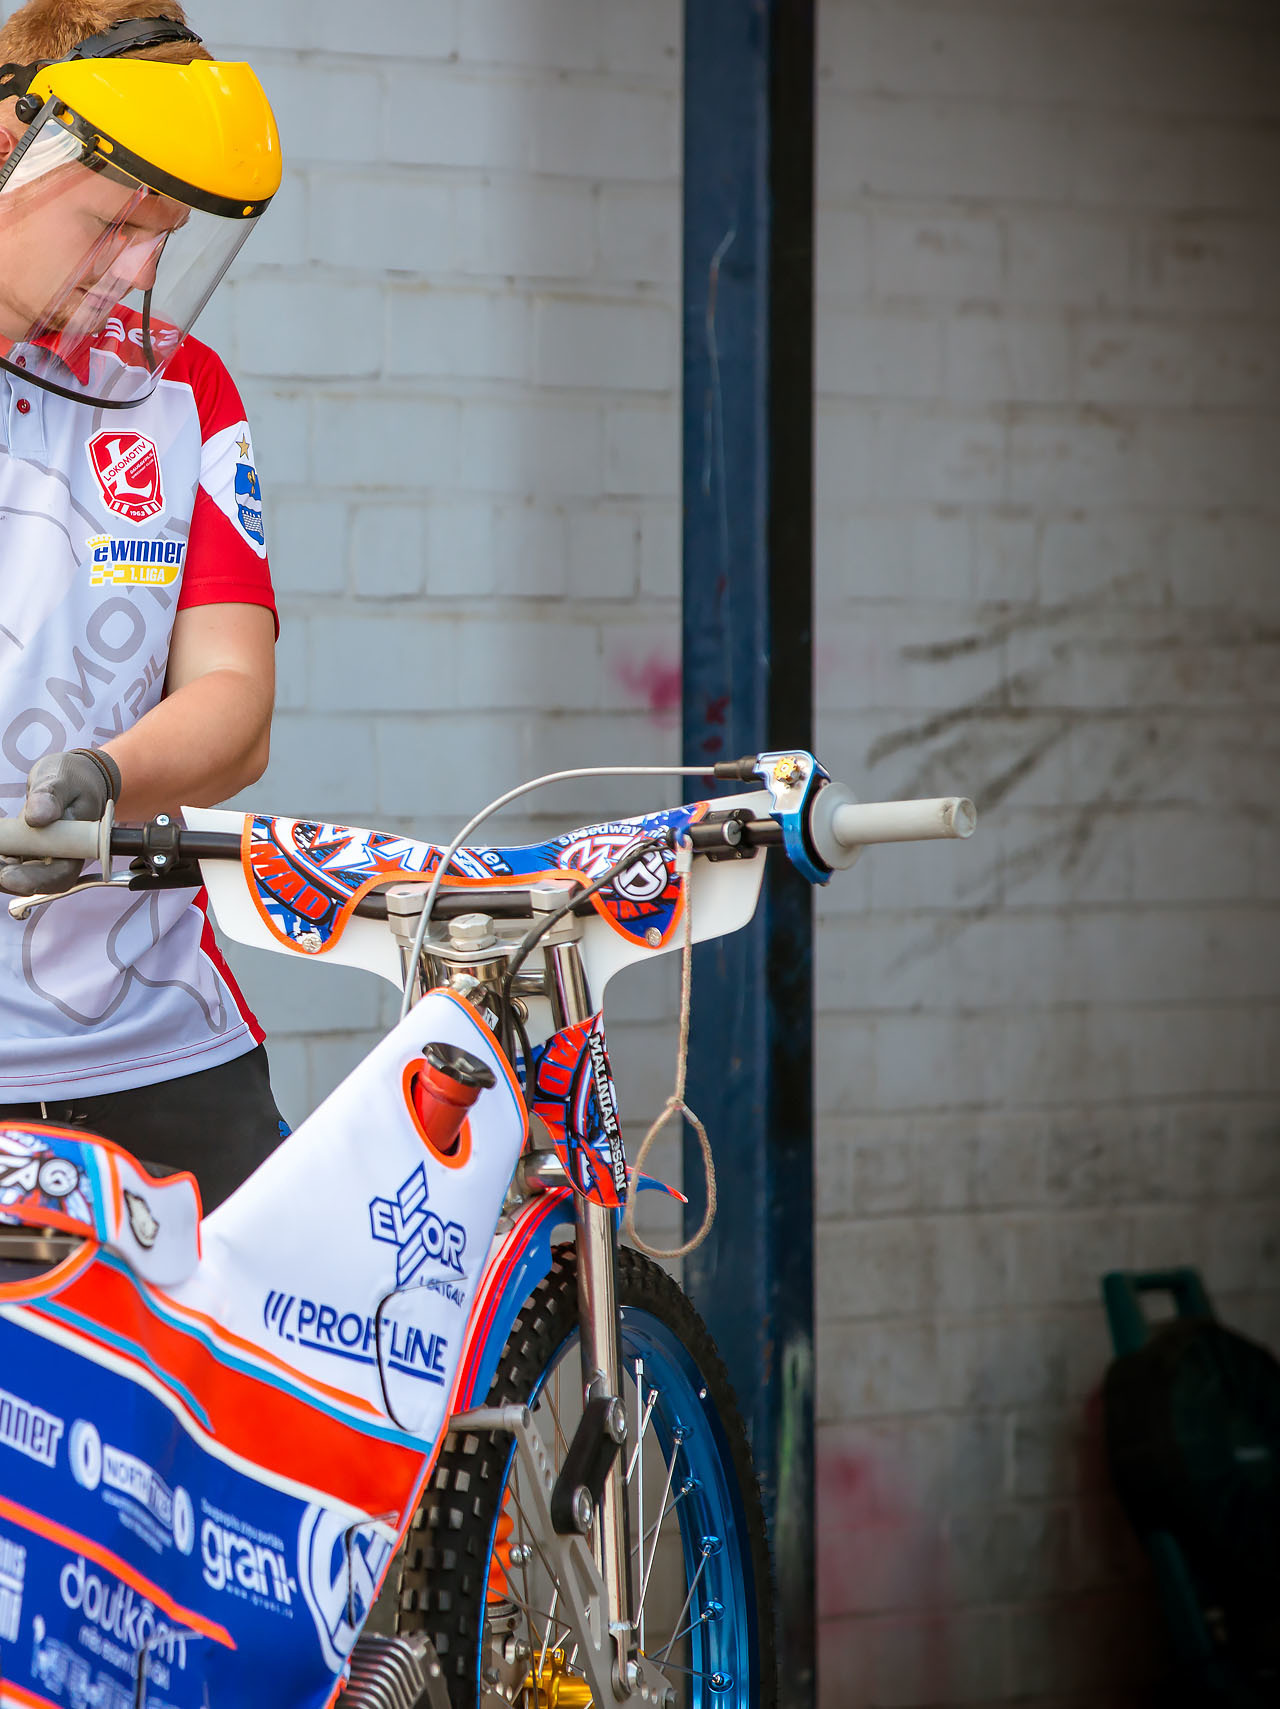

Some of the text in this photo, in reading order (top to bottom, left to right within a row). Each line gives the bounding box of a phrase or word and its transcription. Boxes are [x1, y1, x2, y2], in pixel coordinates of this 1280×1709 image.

[103, 441, 146, 481] LOKOMOTIV
[139, 567, 165, 582] LIGA
[559, 825, 642, 847] speedway
[369, 1160, 466, 1289] EVOR
